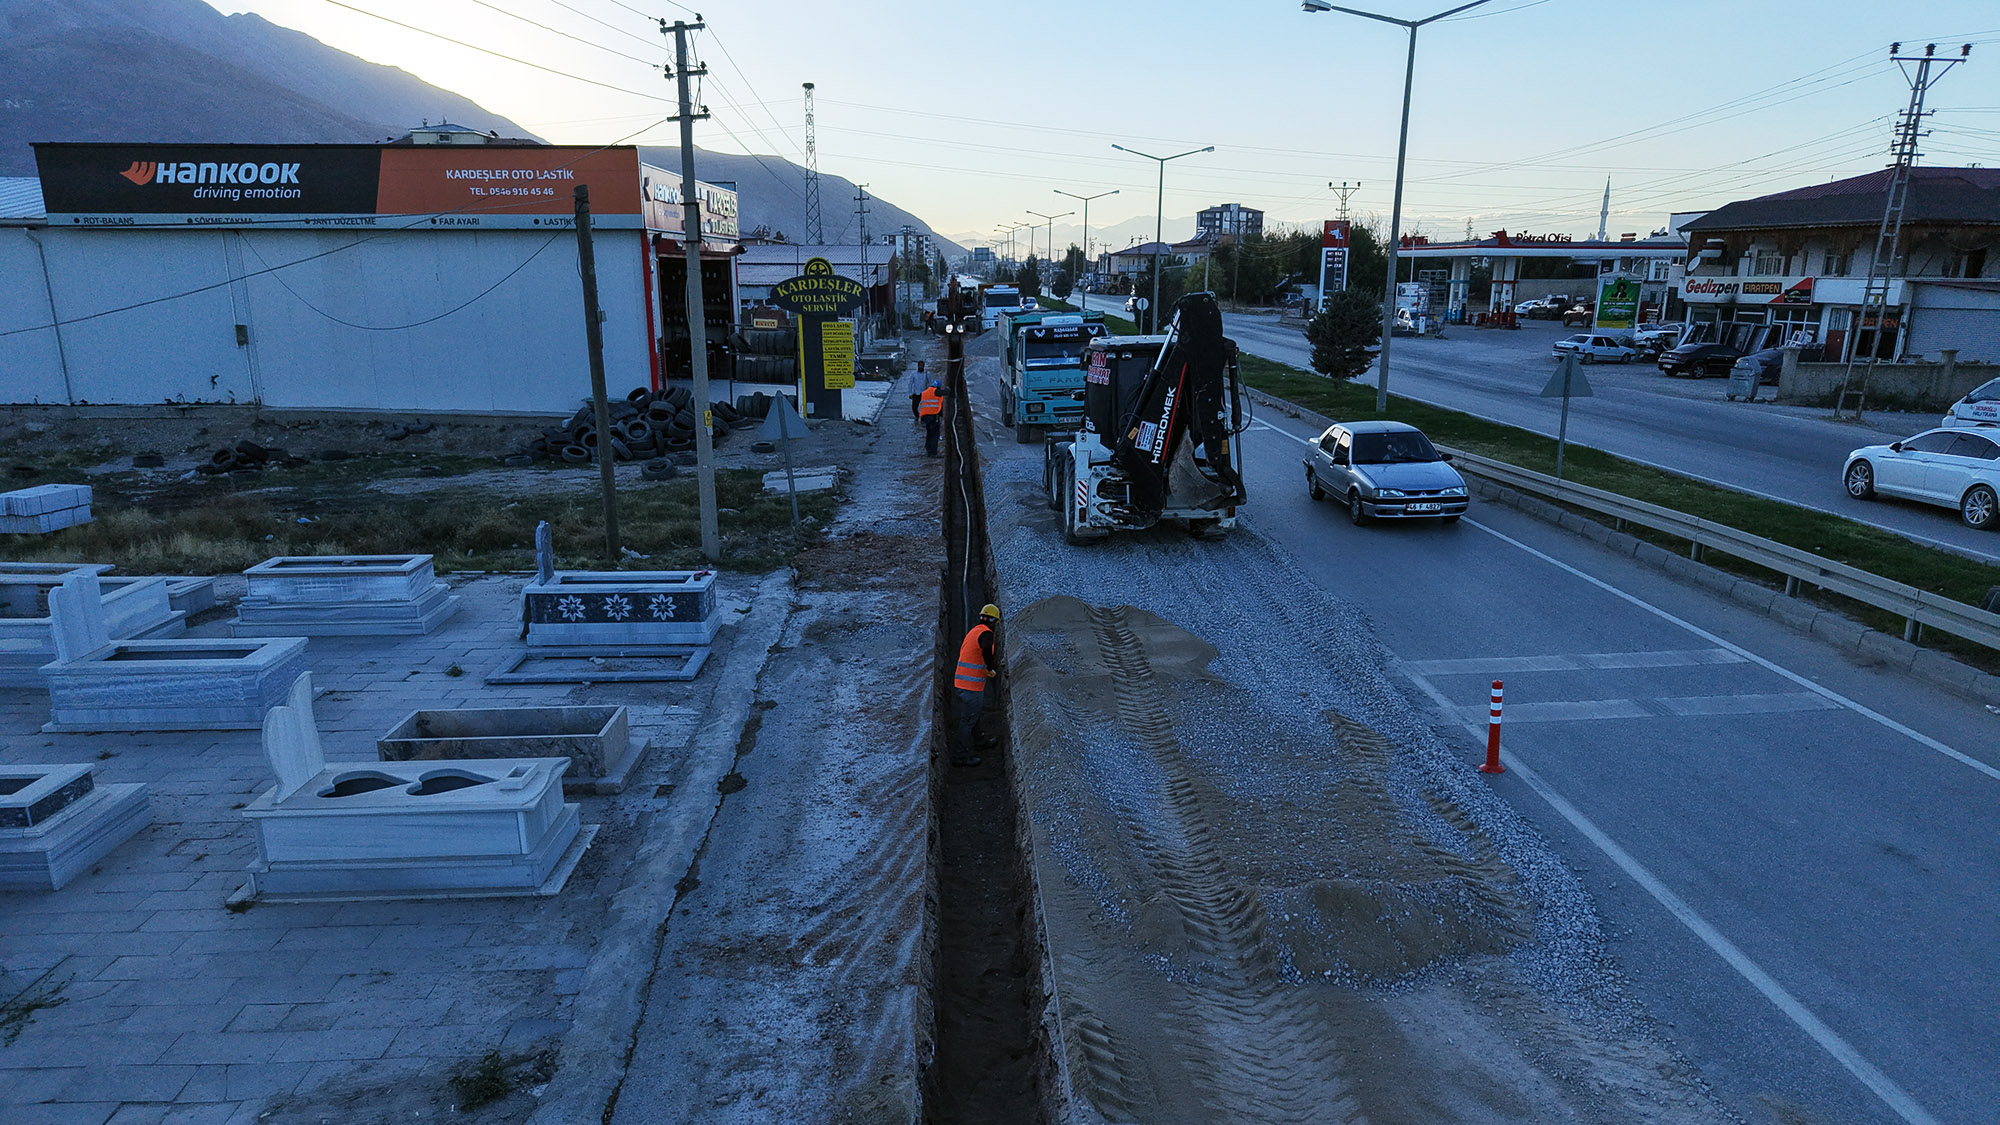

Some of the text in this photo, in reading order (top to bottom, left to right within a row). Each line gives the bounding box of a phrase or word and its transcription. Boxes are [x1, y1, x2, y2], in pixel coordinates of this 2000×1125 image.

[446, 168, 574, 182] KARDEŞLER OTO LASTİK
[193, 187, 301, 202] driving emotion
[470, 187, 555, 196] TEL. 0546 916 45 46
[84, 216, 135, 225] ROT-BALANS
[439, 217, 480, 226] FAR AYARI
[543, 216, 572, 226] LASTİK
[1515, 232, 1572, 243] Petrol Ofisi
[776, 278, 863, 298] KARDEŞLER
[1686, 279, 1739, 298] Gedizpen
[1744, 283, 1781, 293] FIRATPEN
[791, 292, 848, 303] OTO LASTİK
[802, 302, 838, 312] SERVİSİ
